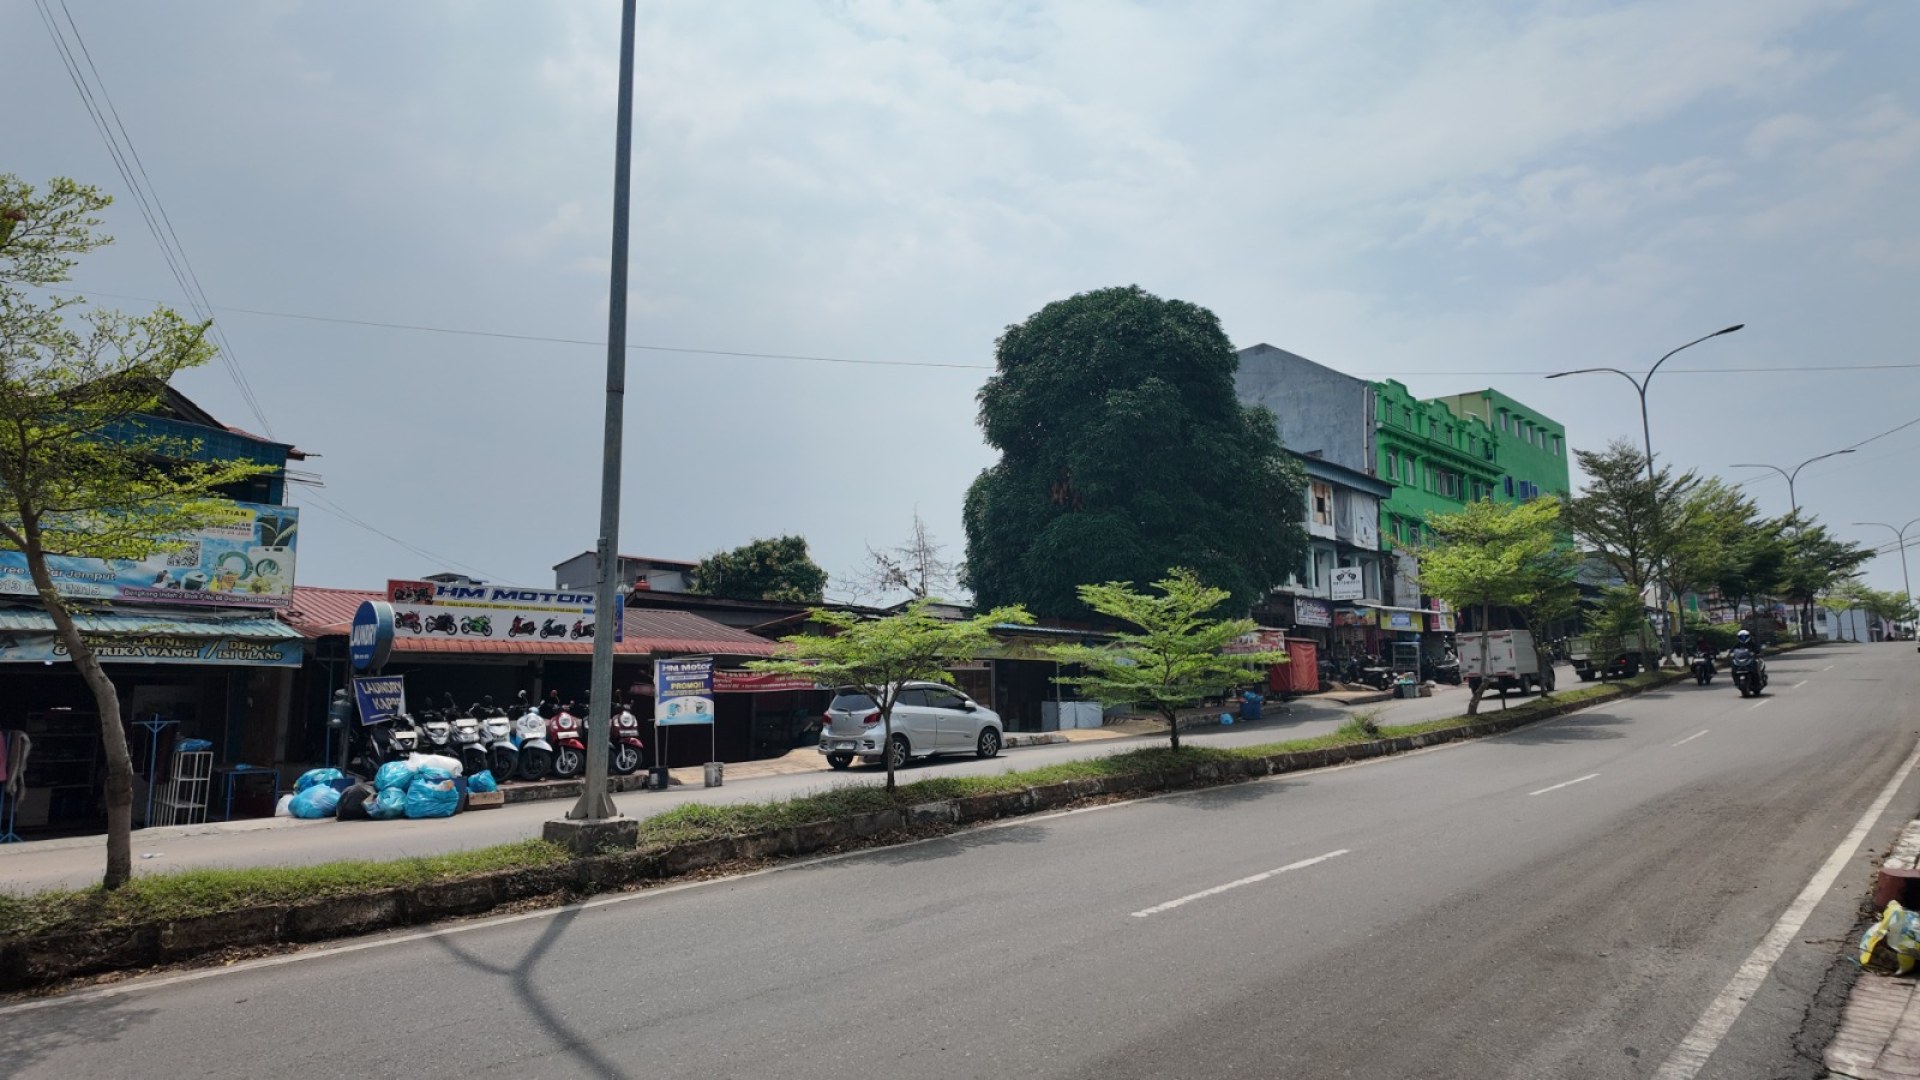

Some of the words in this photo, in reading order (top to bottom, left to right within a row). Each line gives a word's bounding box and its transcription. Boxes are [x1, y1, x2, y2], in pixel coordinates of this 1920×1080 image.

[66, 569, 116, 582] Jemput
[435, 586, 486, 600] HM
[491, 589, 595, 605] MOTOR
[146, 647, 199, 659] WANGI
[217, 650, 235, 659] ISI
[238, 651, 282, 660] ULANG
[662, 664, 679, 672] HM
[681, 663, 711, 672] Motor
[360, 681, 401, 694] LAUNDRY
